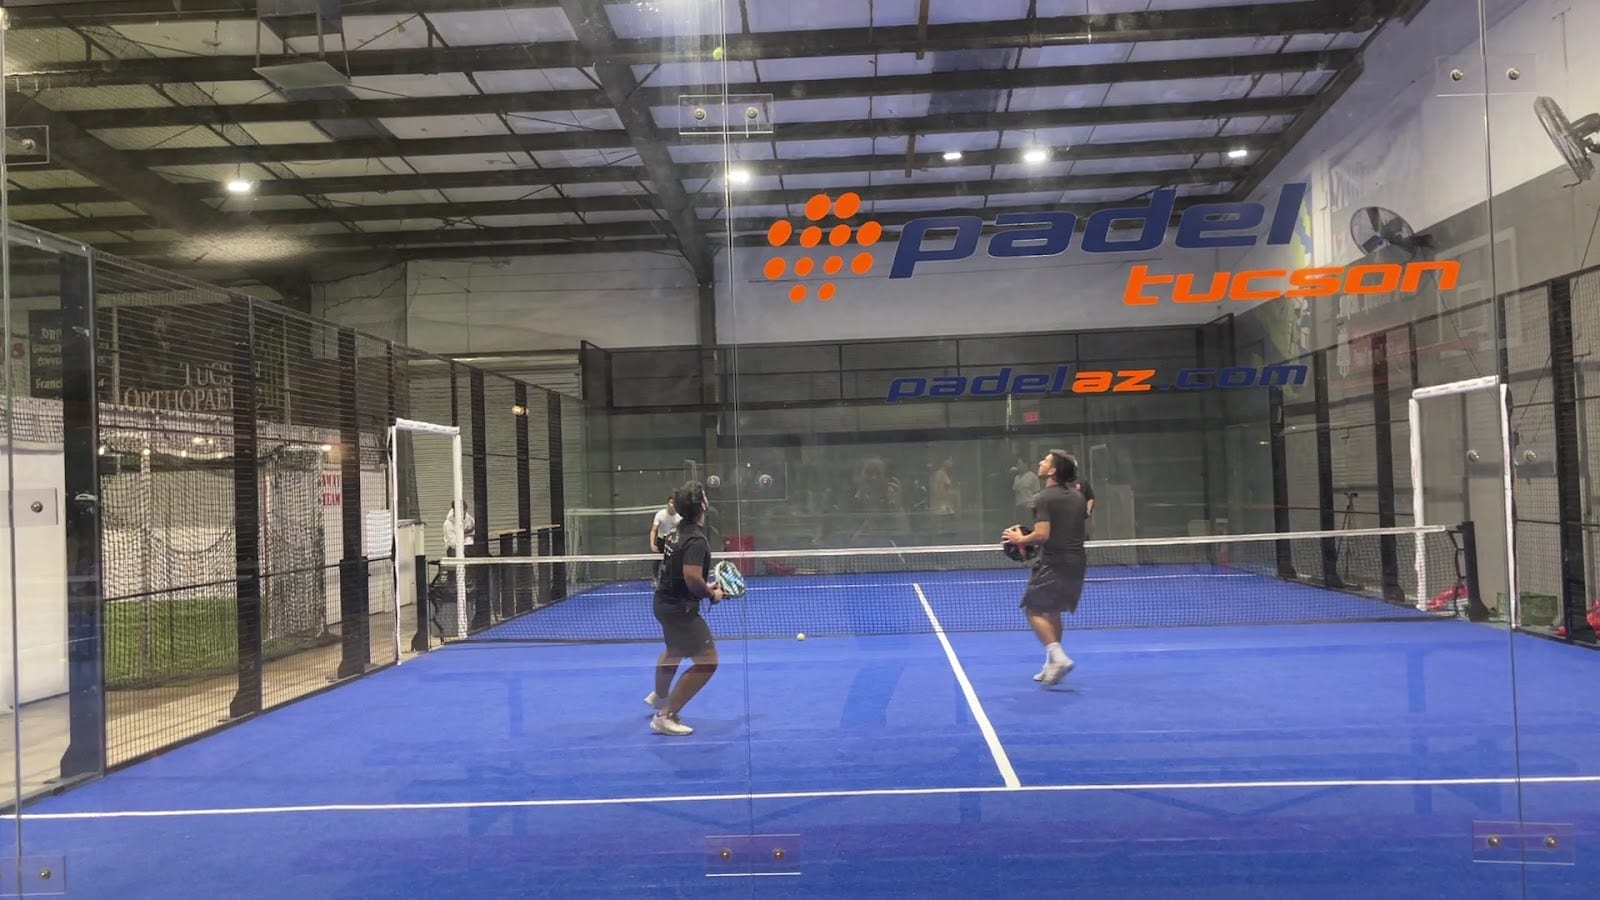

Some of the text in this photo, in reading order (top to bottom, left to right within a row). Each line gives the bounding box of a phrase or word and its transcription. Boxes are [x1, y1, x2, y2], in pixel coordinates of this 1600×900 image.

[889, 183, 1307, 279] padel
[1123, 259, 1460, 306] tucson
[179, 361, 261, 387] TUCS
[124, 386, 262, 411] ORTHOPAE
